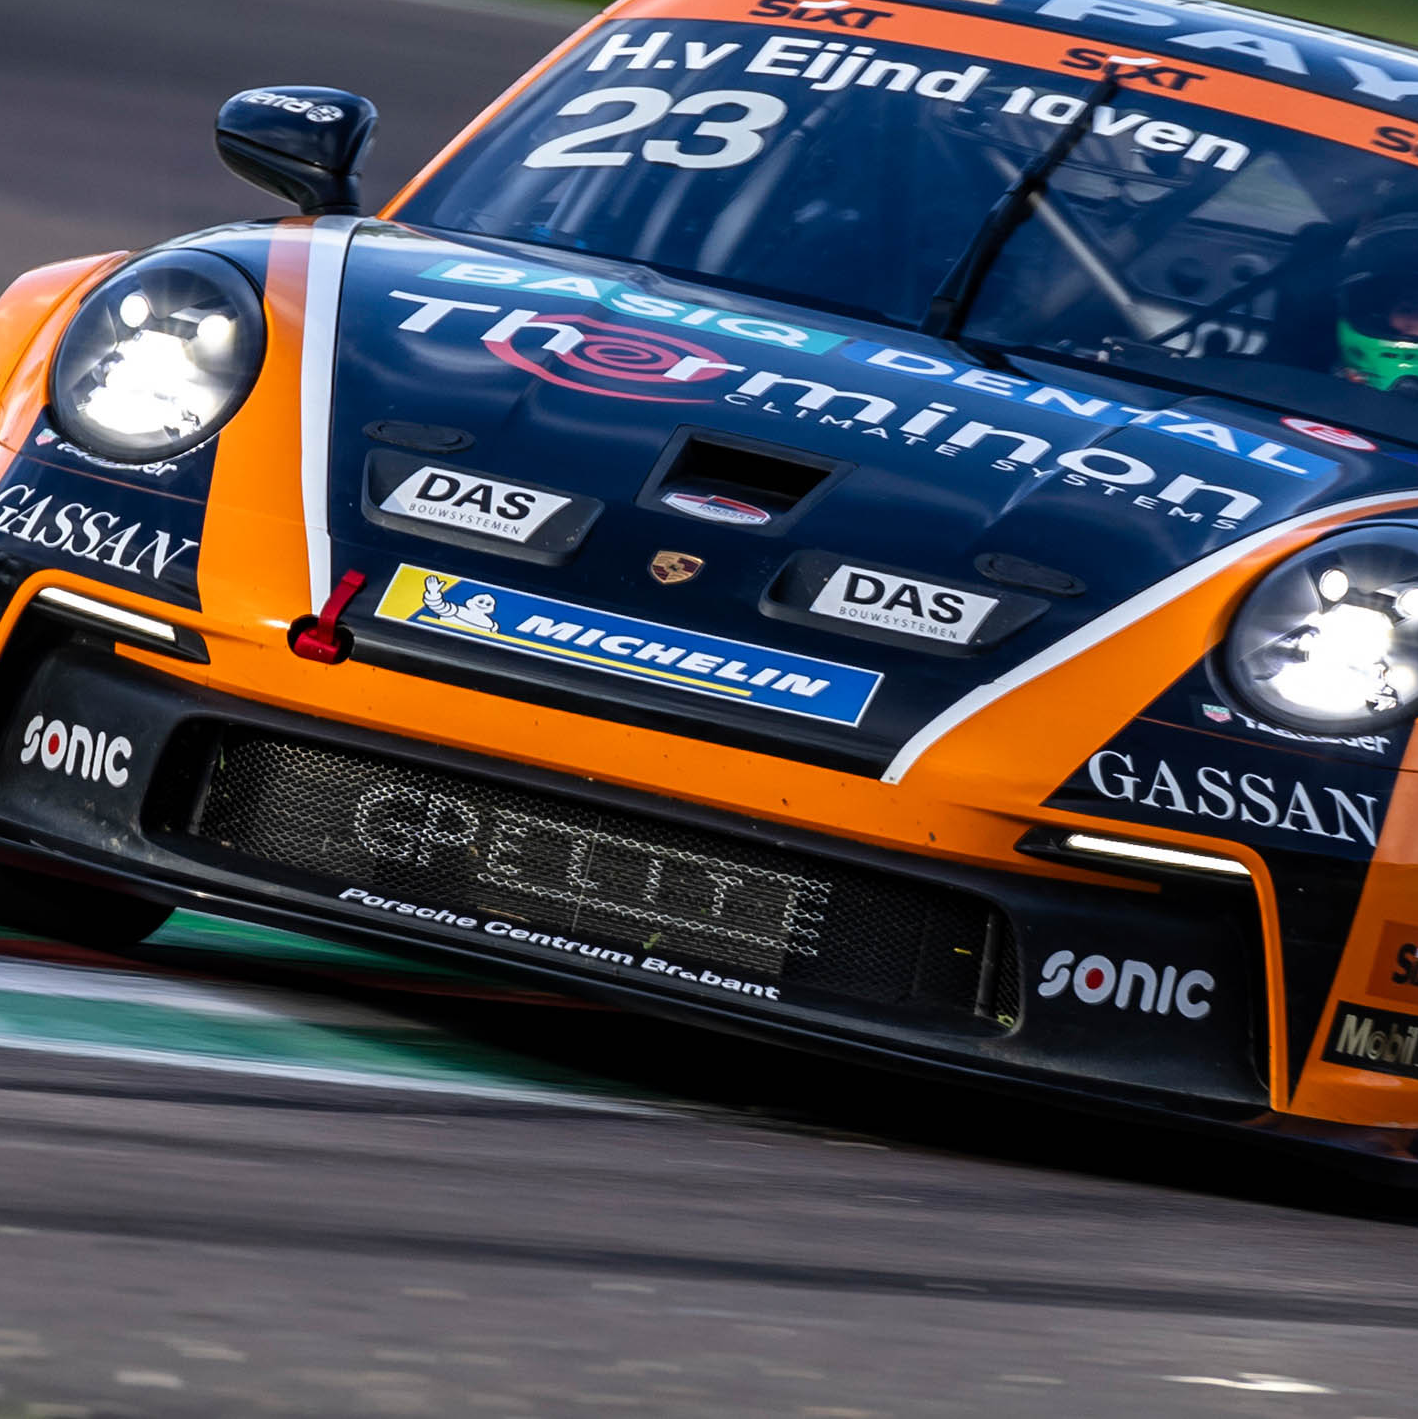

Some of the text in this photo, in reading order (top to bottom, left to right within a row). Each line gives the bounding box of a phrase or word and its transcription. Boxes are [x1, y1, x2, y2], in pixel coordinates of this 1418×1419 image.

[523, 86, 788, 169] 23
[440, 262, 1309, 475] BASIQ DENTAL
[415, 472, 537, 521] DAS
[723, 393, 1242, 531] CLIMATE SYSTEMS
[408, 502, 522, 535] BOUWSYSTEMEN
[838, 605, 958, 640] BOUWSYSTEMEN
[842, 571, 965, 625] DAS
[515, 614, 831, 699] MICHELIN
[1088, 749, 1379, 848] GASSAN
[338, 886, 478, 930] Porsche
[483, 920, 635, 966] Centrum
